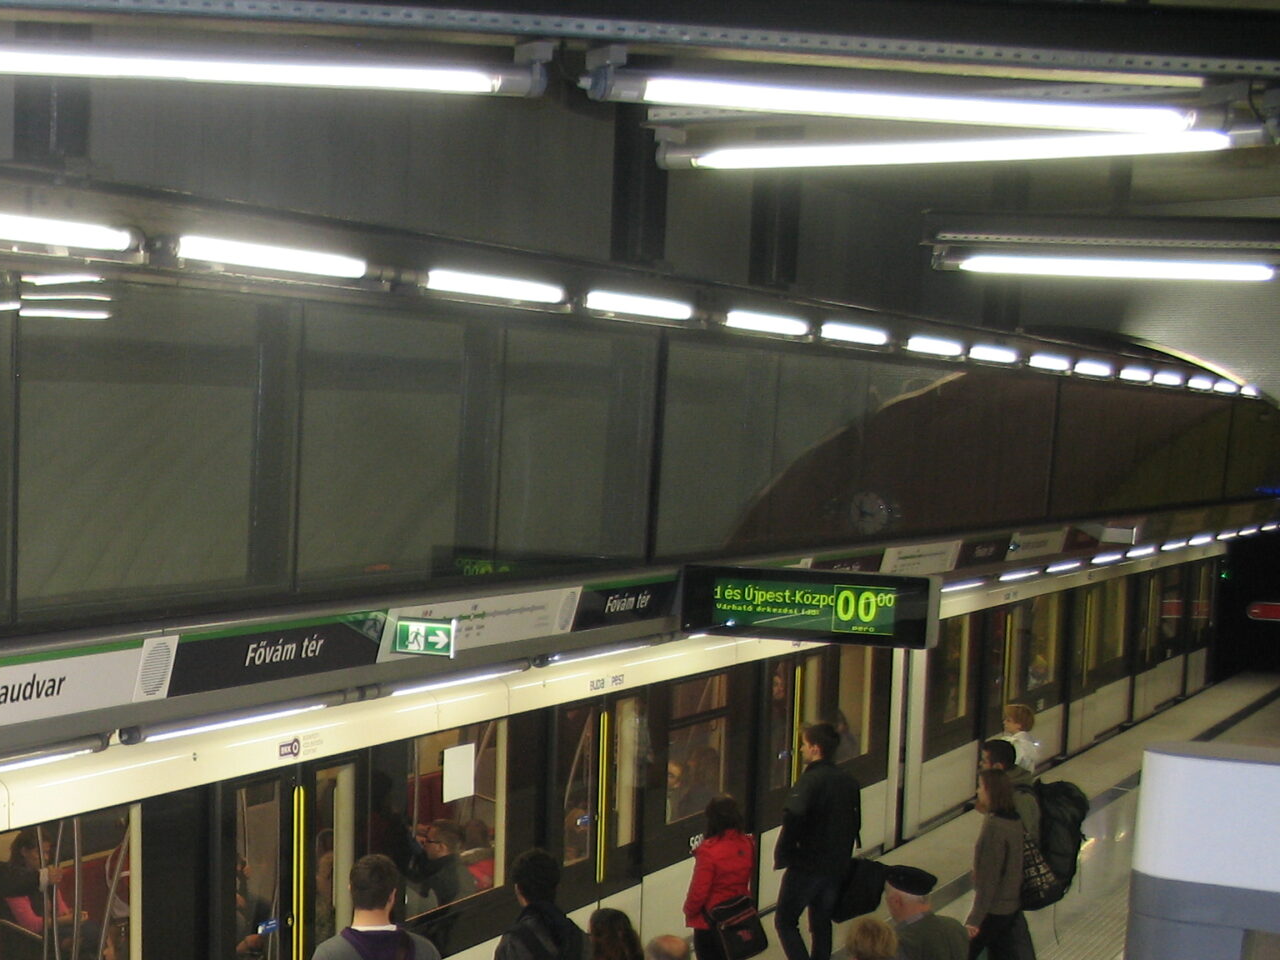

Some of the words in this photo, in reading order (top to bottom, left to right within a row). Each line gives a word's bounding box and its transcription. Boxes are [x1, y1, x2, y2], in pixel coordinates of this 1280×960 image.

[605, 592, 635, 613] Fővám
[724, 584, 741, 600] és
[837, 590, 876, 622] 00
[245, 638, 296, 667] Fővám
[301, 634, 325, 658] tér
